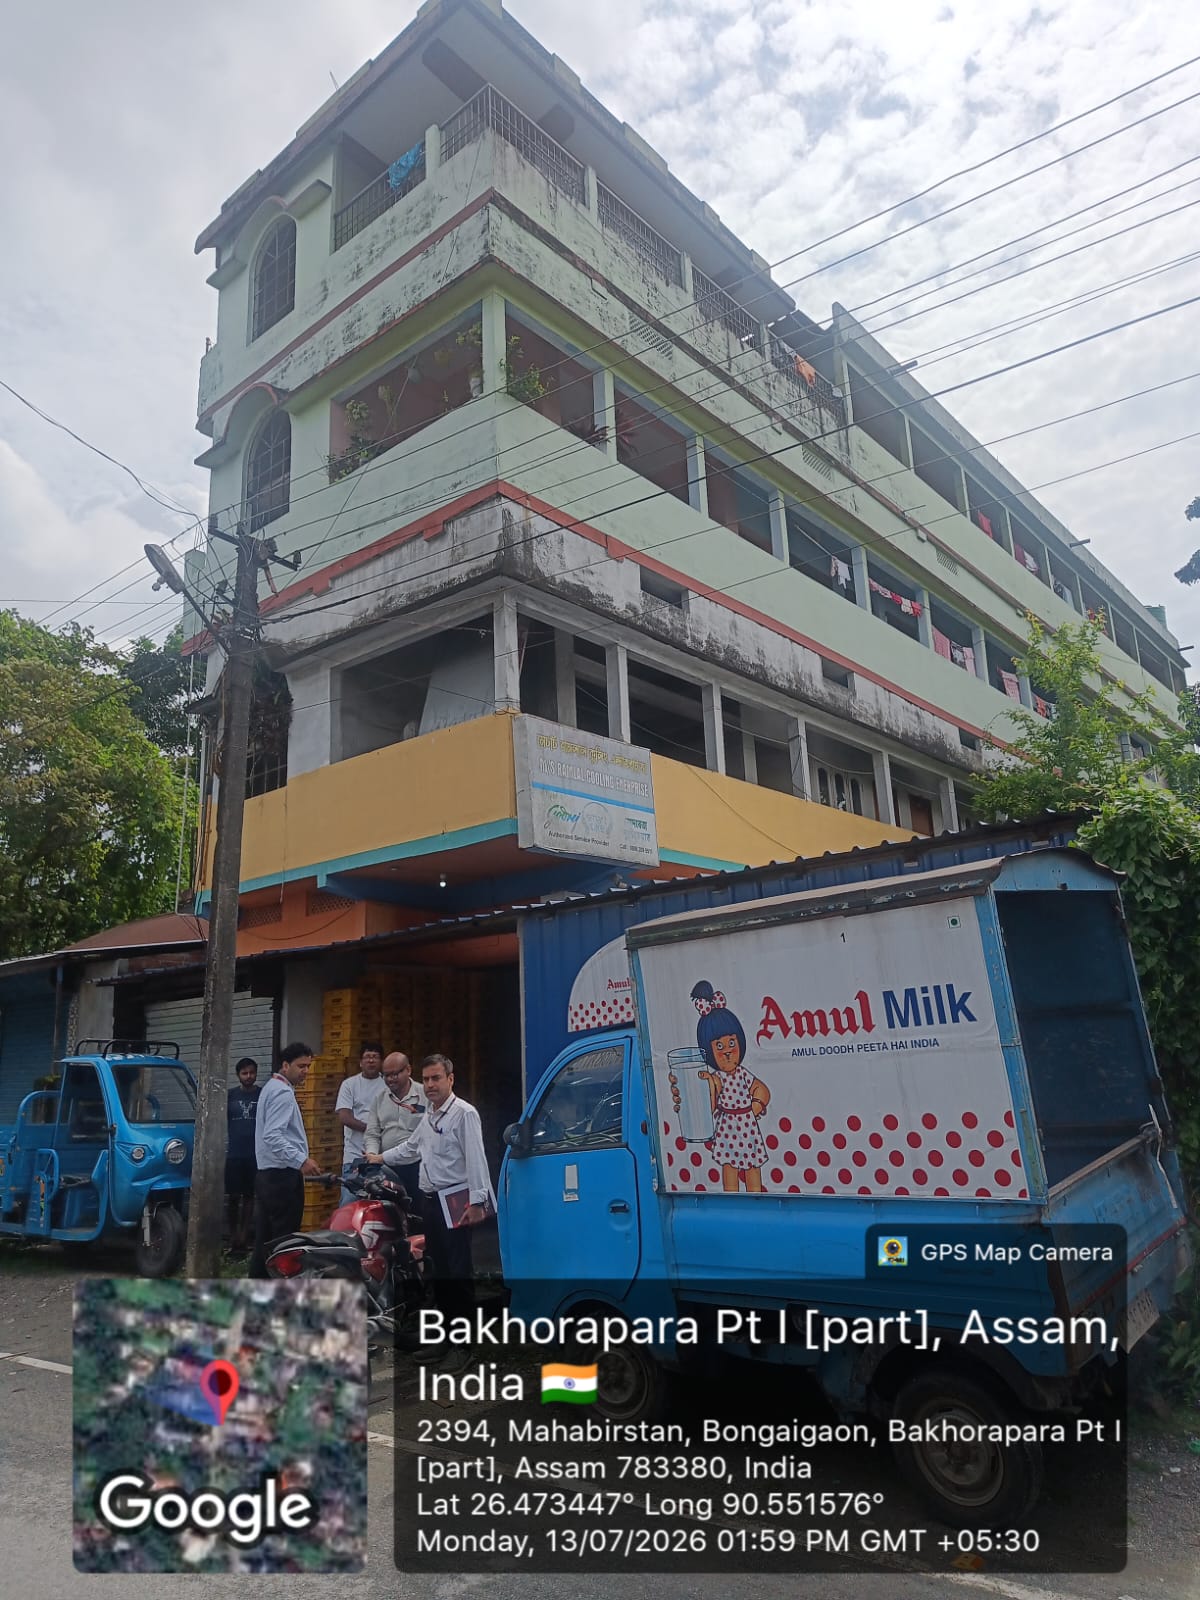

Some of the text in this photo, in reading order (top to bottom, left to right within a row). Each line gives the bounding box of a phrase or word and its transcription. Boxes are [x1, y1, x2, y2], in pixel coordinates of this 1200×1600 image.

[586, 769, 614, 789] COOLING
[607, 977, 631, 991] Amul
[756, 984, 977, 1047] Amul Milk
[791, 1037, 940, 1058] AMUL DOODH PEETA HAI INDIA
